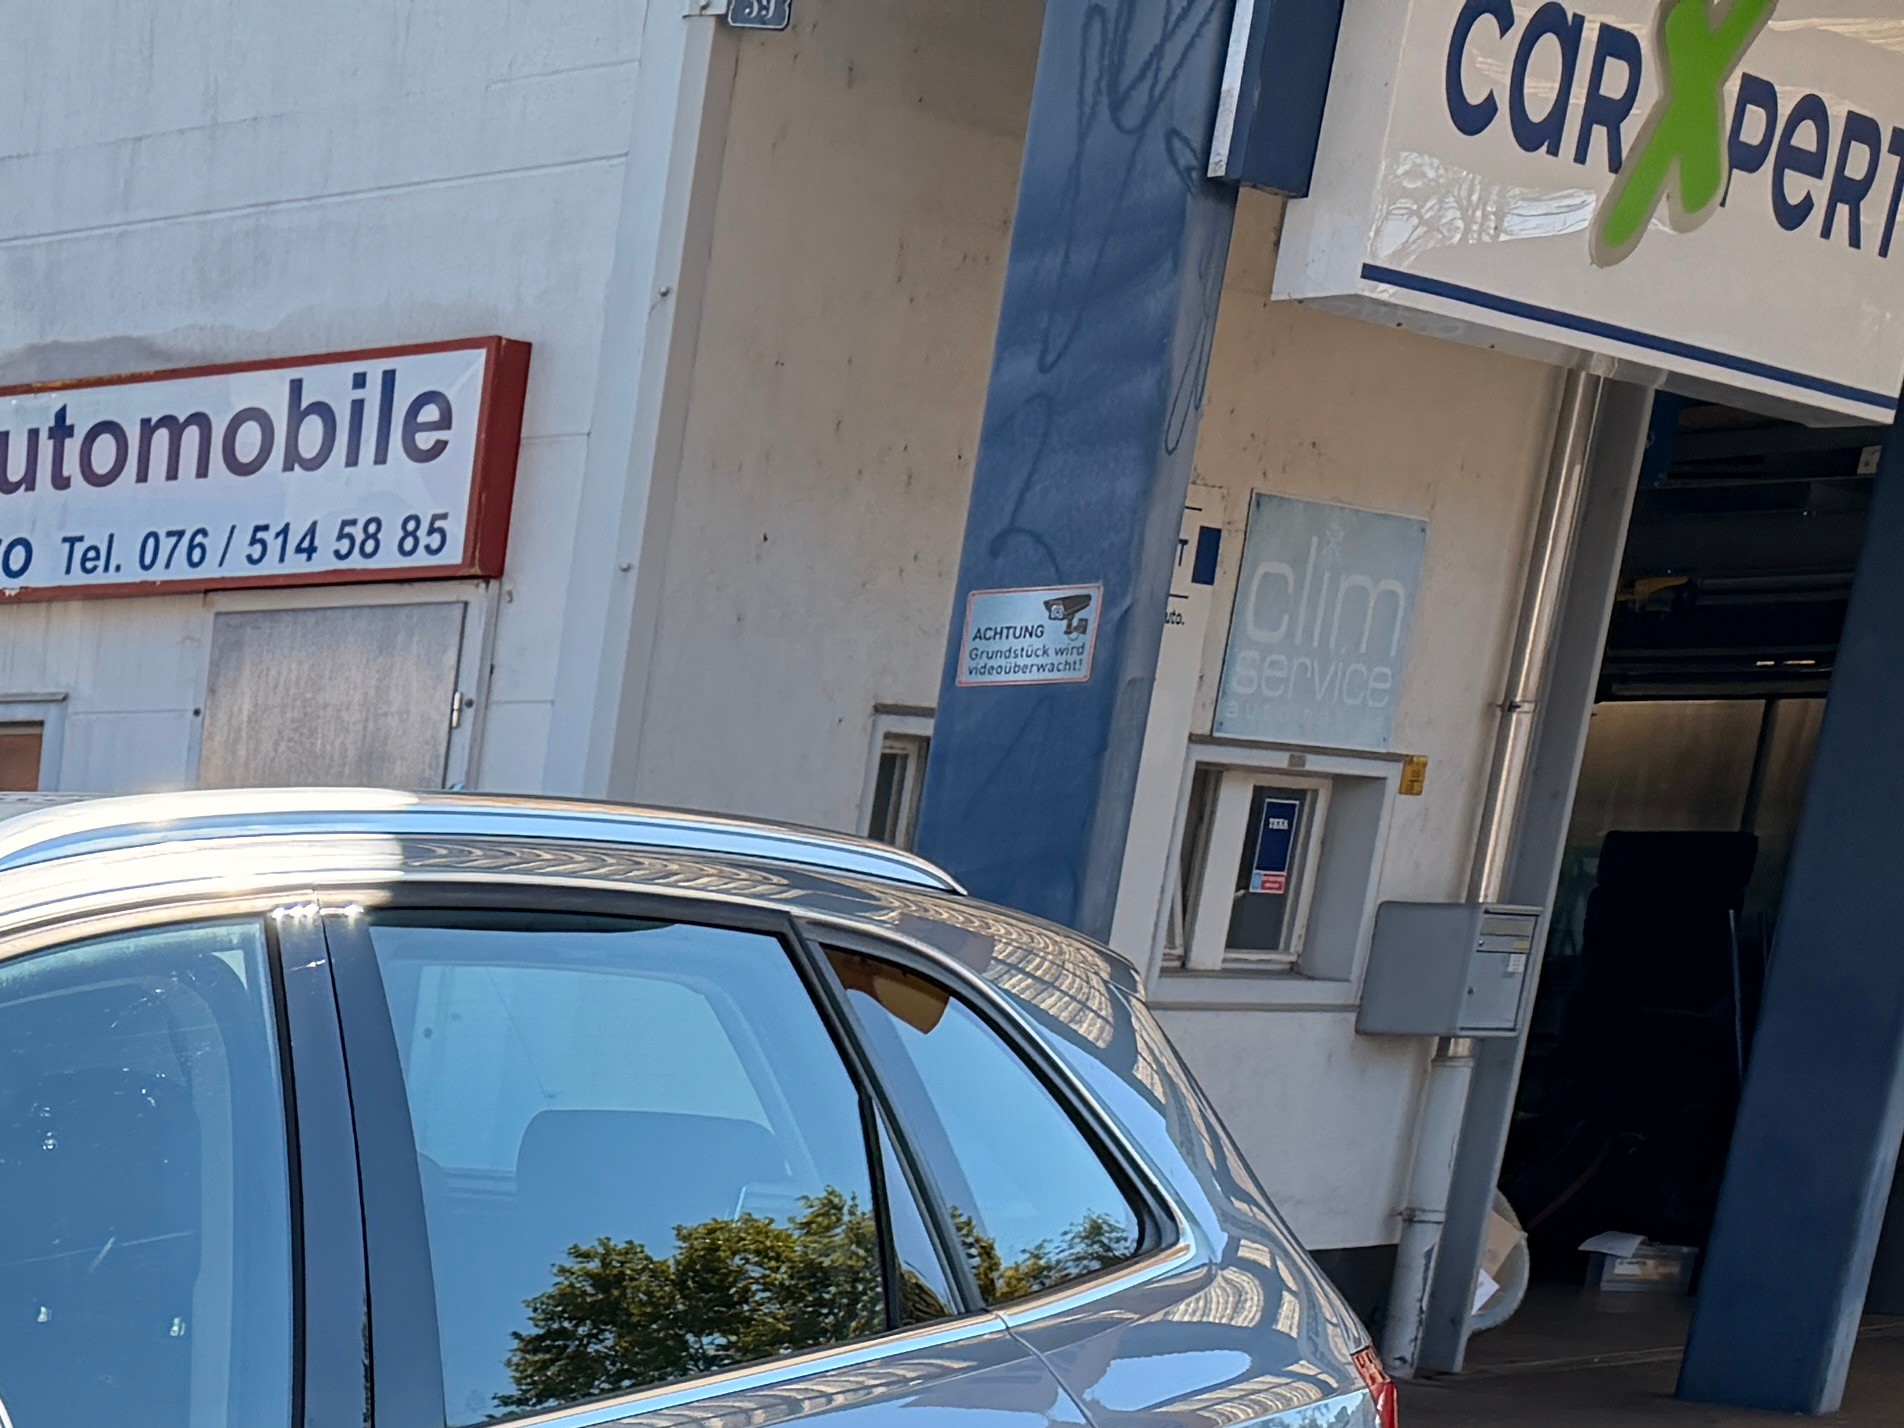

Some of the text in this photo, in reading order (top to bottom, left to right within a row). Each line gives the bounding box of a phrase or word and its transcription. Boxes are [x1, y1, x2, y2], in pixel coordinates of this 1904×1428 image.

[61, 533, 122, 576] Tel.
[139, 526, 208, 572] 076
[218, 523, 237, 570] /
[246, 519, 318, 566] 514
[333, 515, 382, 561] 58
[396, 510, 449, 557] 85
[972, 624, 1045, 642] ACHTUNG
[969, 642, 1086, 661] Grundstück wird
[968, 659, 1083, 676] videoüberwacht!
[1231, 650, 1392, 708] service
